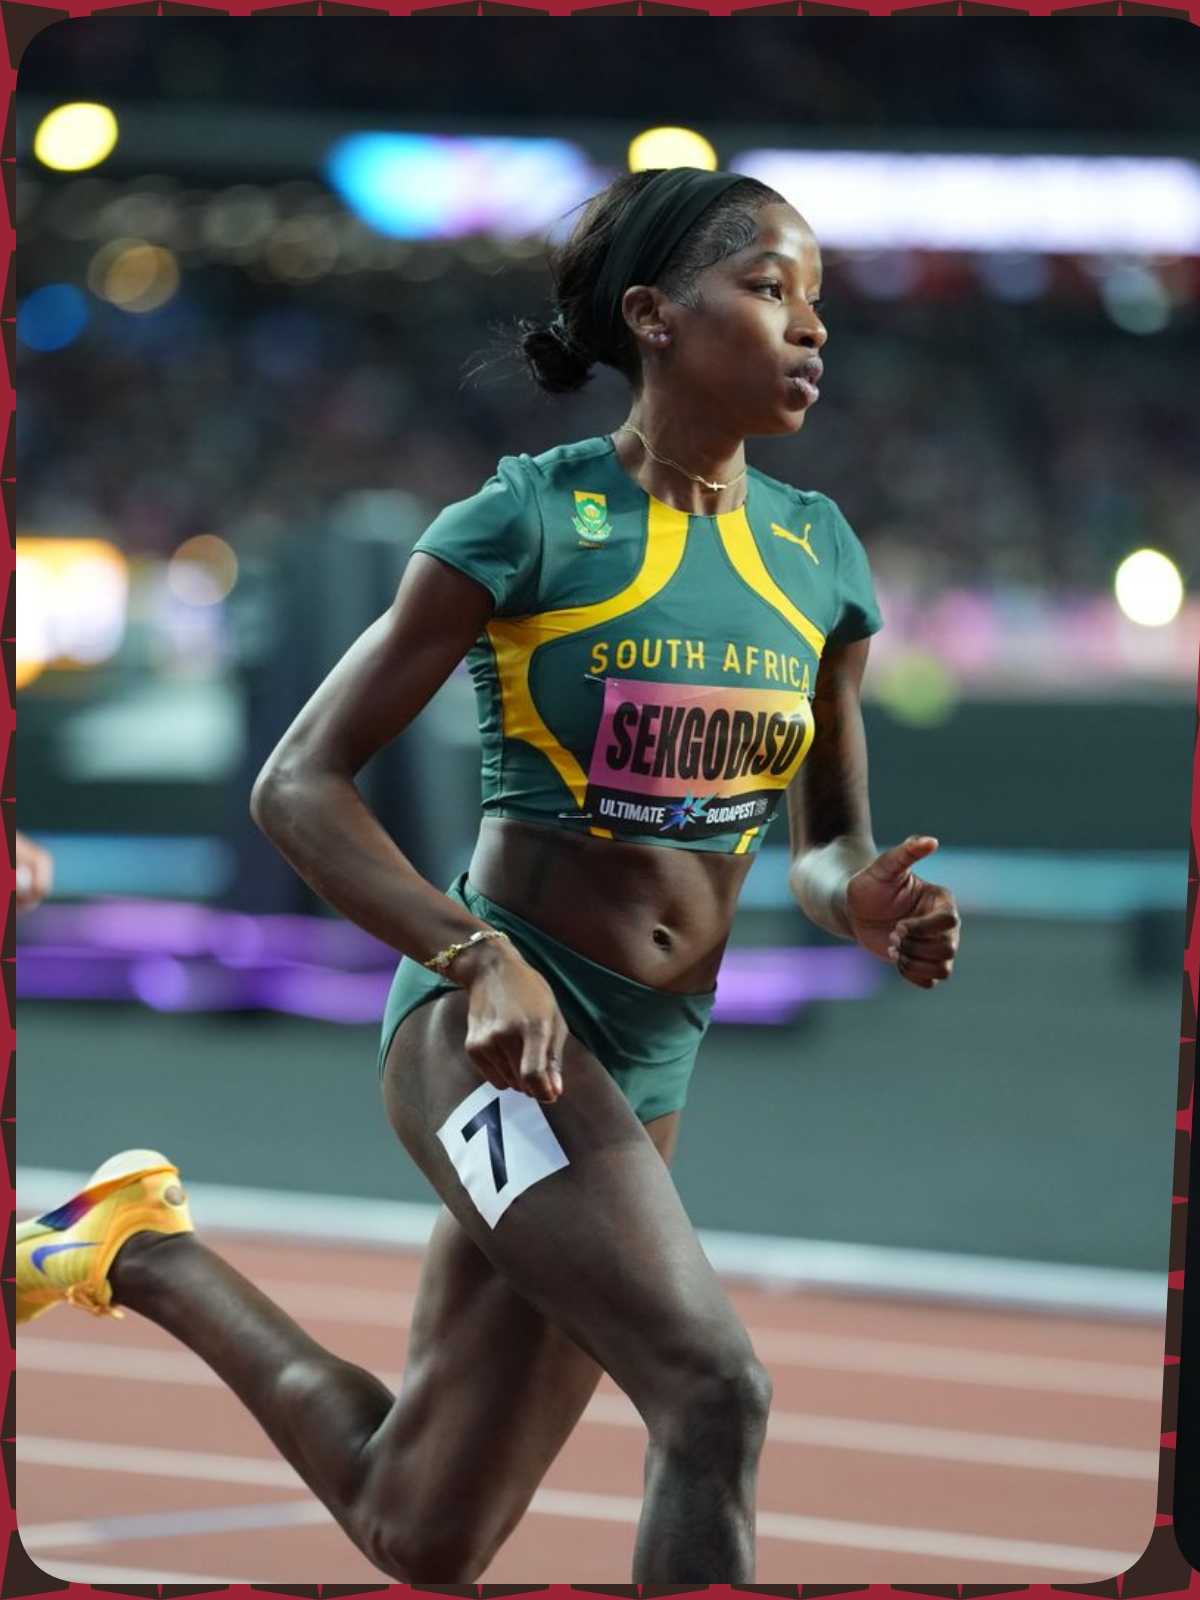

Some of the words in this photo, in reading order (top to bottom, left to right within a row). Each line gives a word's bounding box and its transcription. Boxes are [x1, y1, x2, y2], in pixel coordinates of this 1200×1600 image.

[590, 638, 704, 675] SOUTH
[723, 643, 811, 692] AFRICA
[606, 701, 806, 782] SEKGODISO
[600, 798, 665, 824] ULTIMATE
[706, 800, 756, 824] BUDAPEST
[460, 1096, 508, 1194] 7
